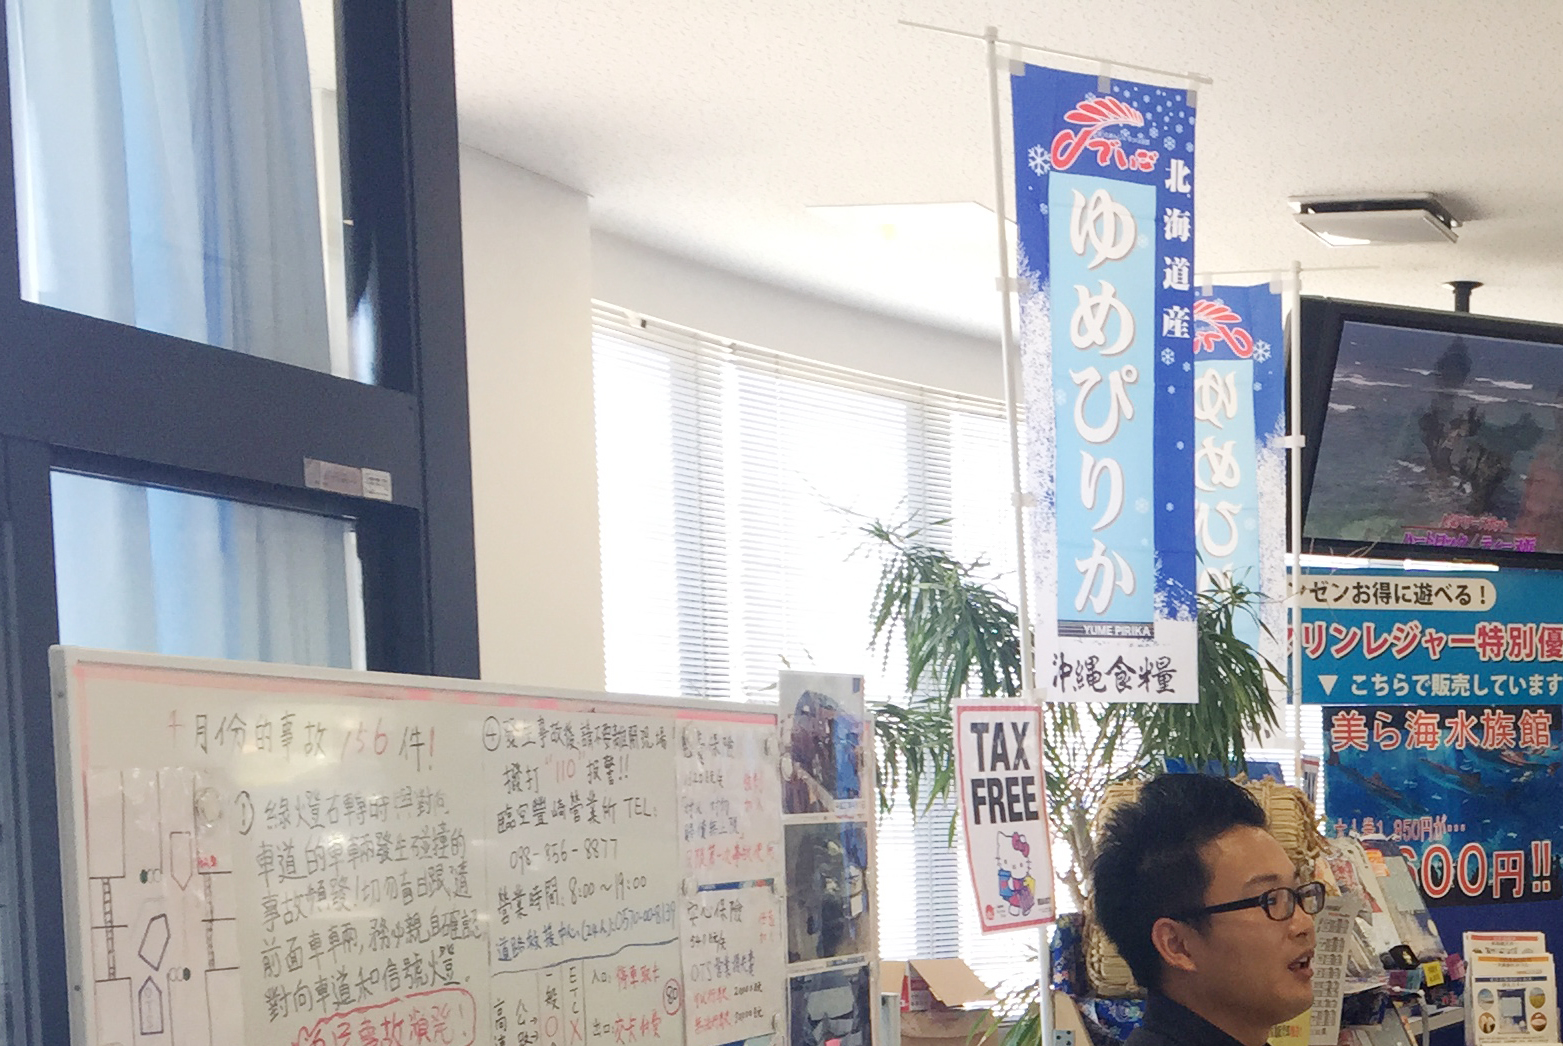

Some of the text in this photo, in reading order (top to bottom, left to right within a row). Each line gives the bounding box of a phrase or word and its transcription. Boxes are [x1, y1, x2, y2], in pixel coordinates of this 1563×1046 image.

[1162, 157, 1191, 341] 北海道産
[1068, 187, 1139, 617] ゆめぴりか
[1083, 624, 1151, 638] YUME PIRIKA
[1052, 652, 1178, 695] 沖縄食糧
[1351, 674, 1563, 697] こちらで販売しています
[970, 721, 1031, 773] TAX
[1331, 709, 1553, 752] 美ら海水族館
[970, 775, 1040, 826] FREE
